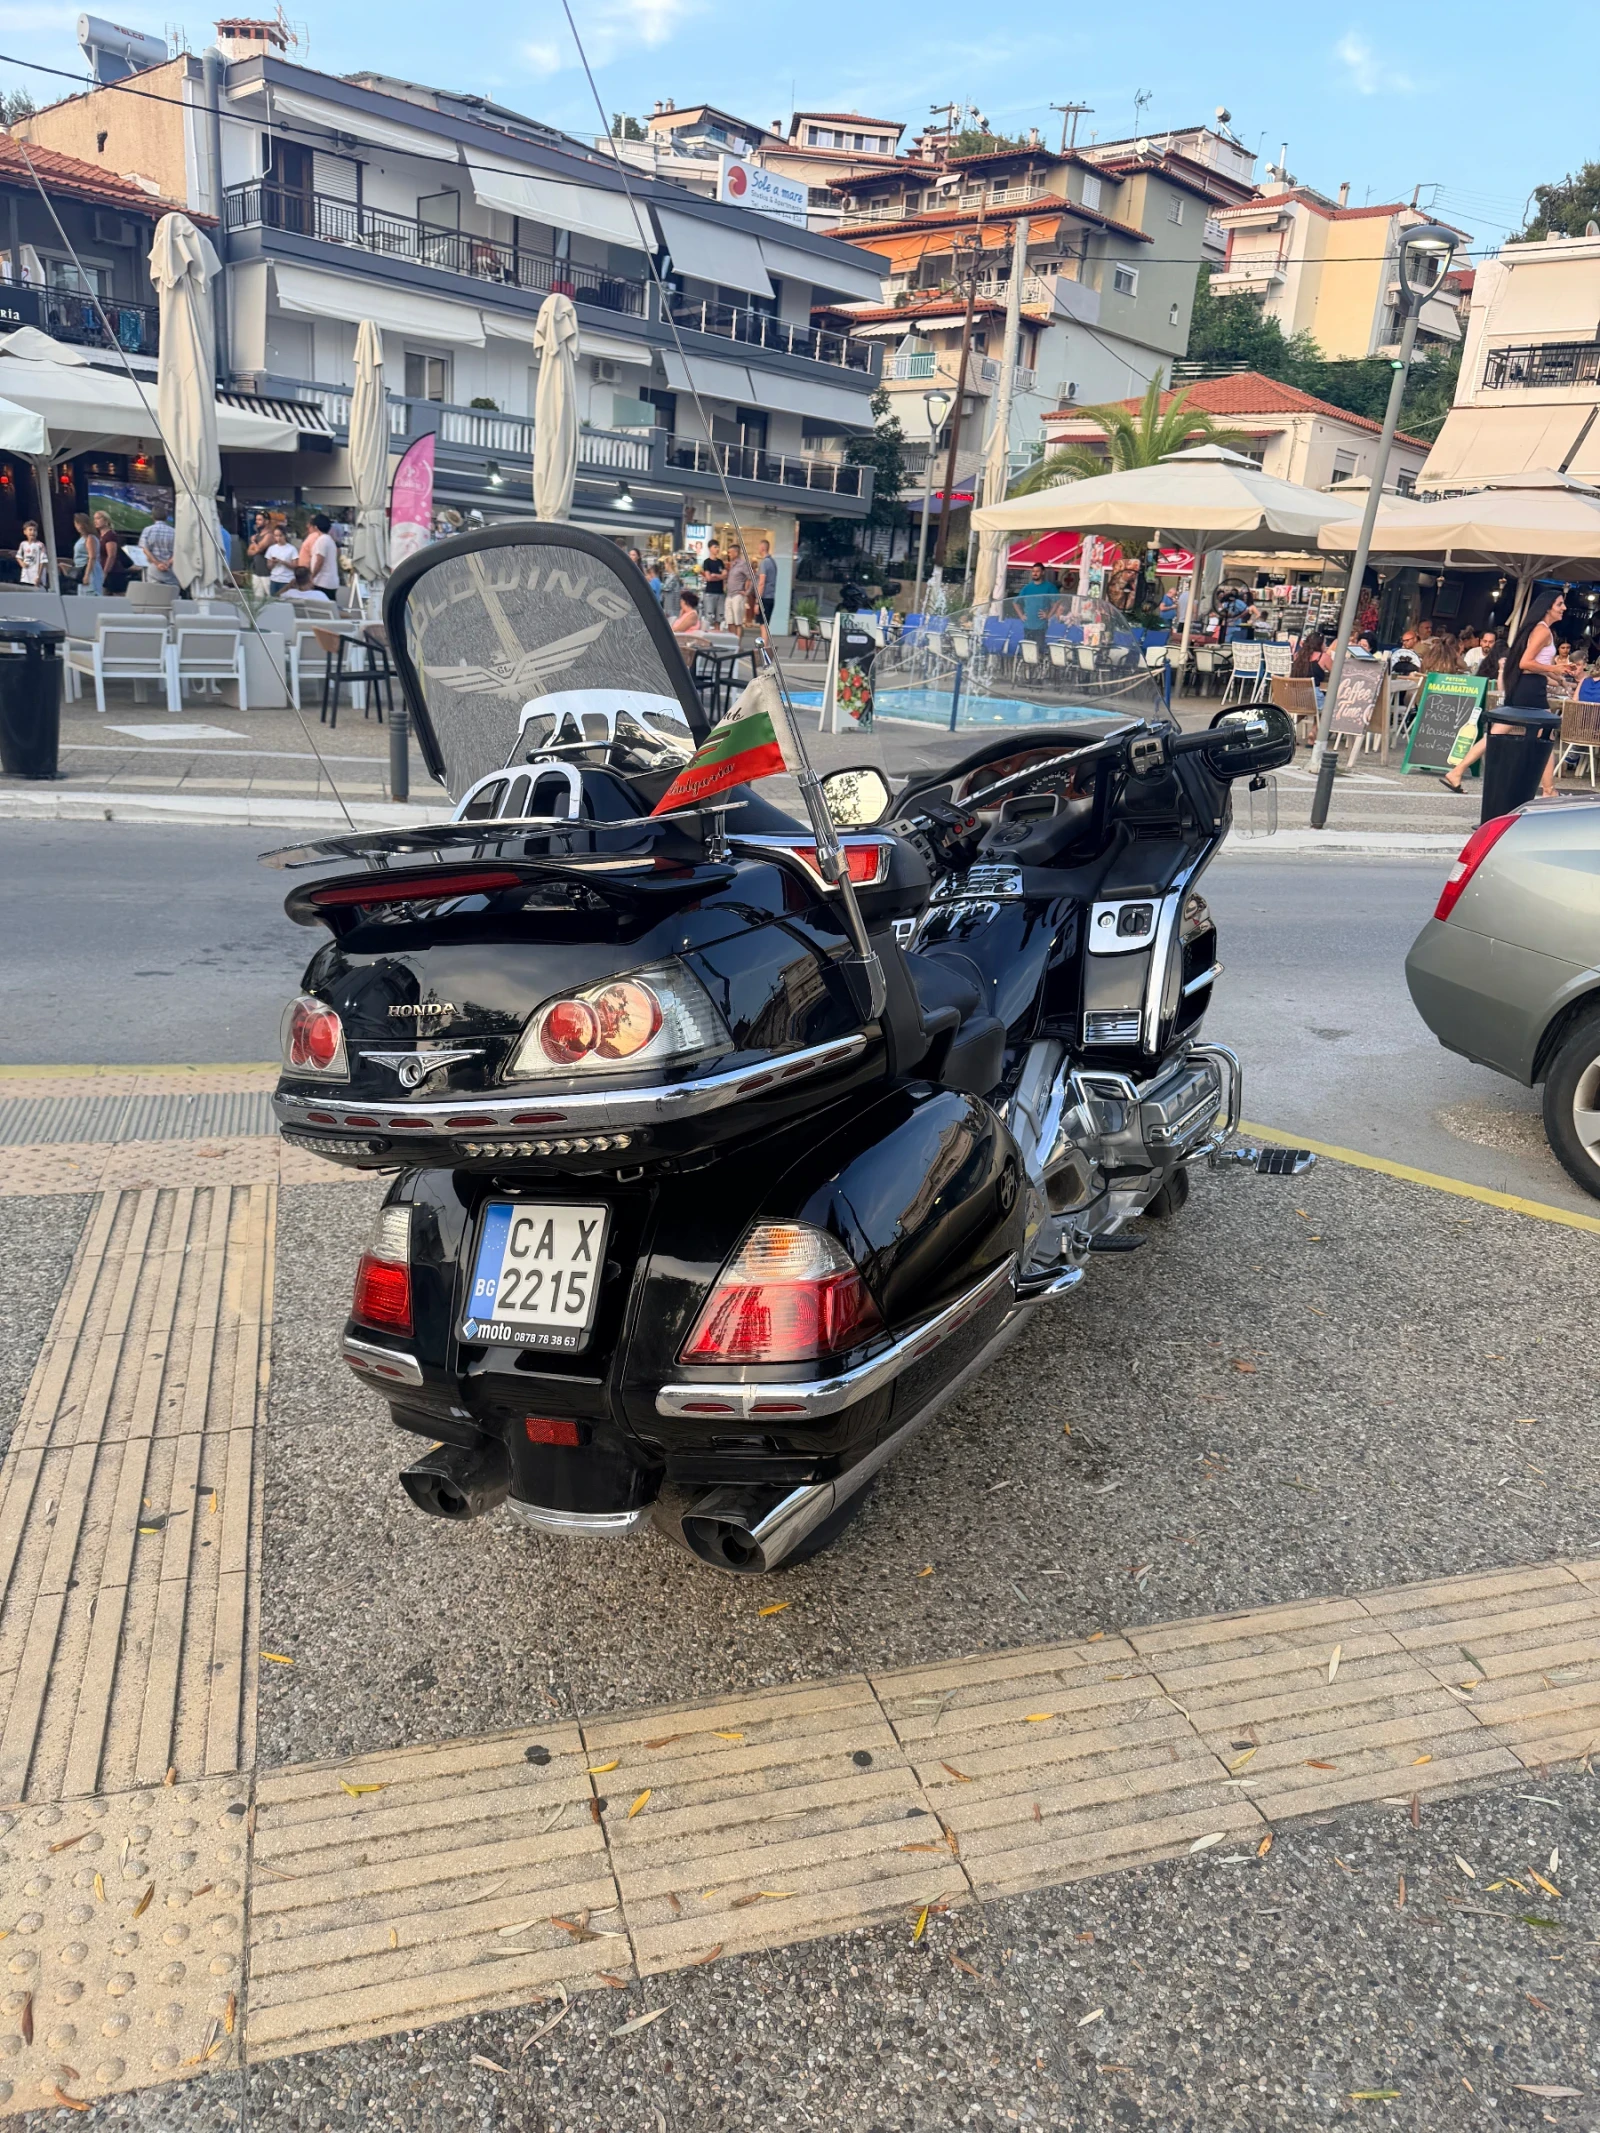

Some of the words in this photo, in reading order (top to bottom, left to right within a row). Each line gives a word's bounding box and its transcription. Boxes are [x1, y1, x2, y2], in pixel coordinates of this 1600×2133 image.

[121, 27, 145, 41] ELCO
[751, 171, 772, 192] Sole
[773, 186, 779, 195] a
[781, 188, 803, 203] mare
[1337, 678, 1371, 703] Coffee
[1336, 700, 1362, 720] Time
[387, 1002, 458, 1018] HONDA
[509, 1217, 554, 1260] CA
[572, 1219, 598, 1261] X
[474, 1278, 496, 1297] BG
[497, 1268, 588, 1314] 2215
[477, 1322, 512, 1341] moto
[514, 1332, 536, 1343] 0878
[538, 1333, 549, 1344] 78
[550, 1335, 563, 1346] 38
[564, 1336, 576, 1347] 63
